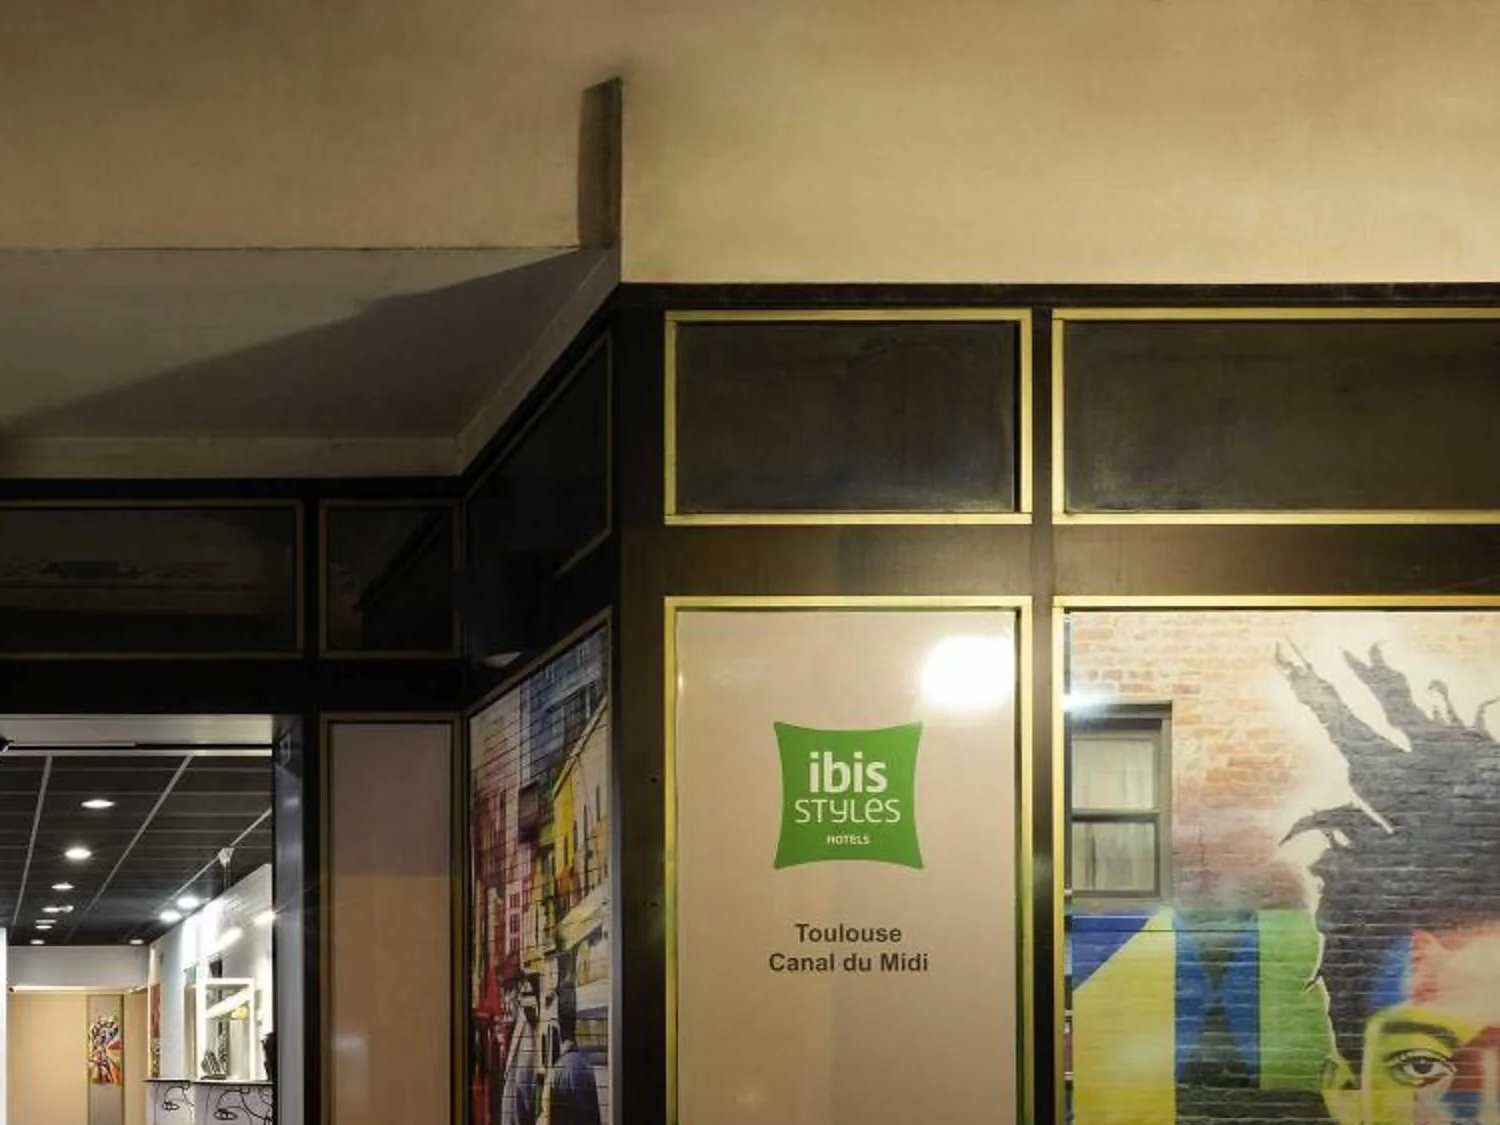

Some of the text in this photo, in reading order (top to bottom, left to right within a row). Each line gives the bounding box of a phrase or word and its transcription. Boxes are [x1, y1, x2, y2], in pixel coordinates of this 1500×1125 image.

[808, 751, 889, 794] ibis
[826, 834, 870, 846] HOTELS
[795, 923, 903, 943] Toulouse
[769, 952, 930, 973] Canal du Midi
